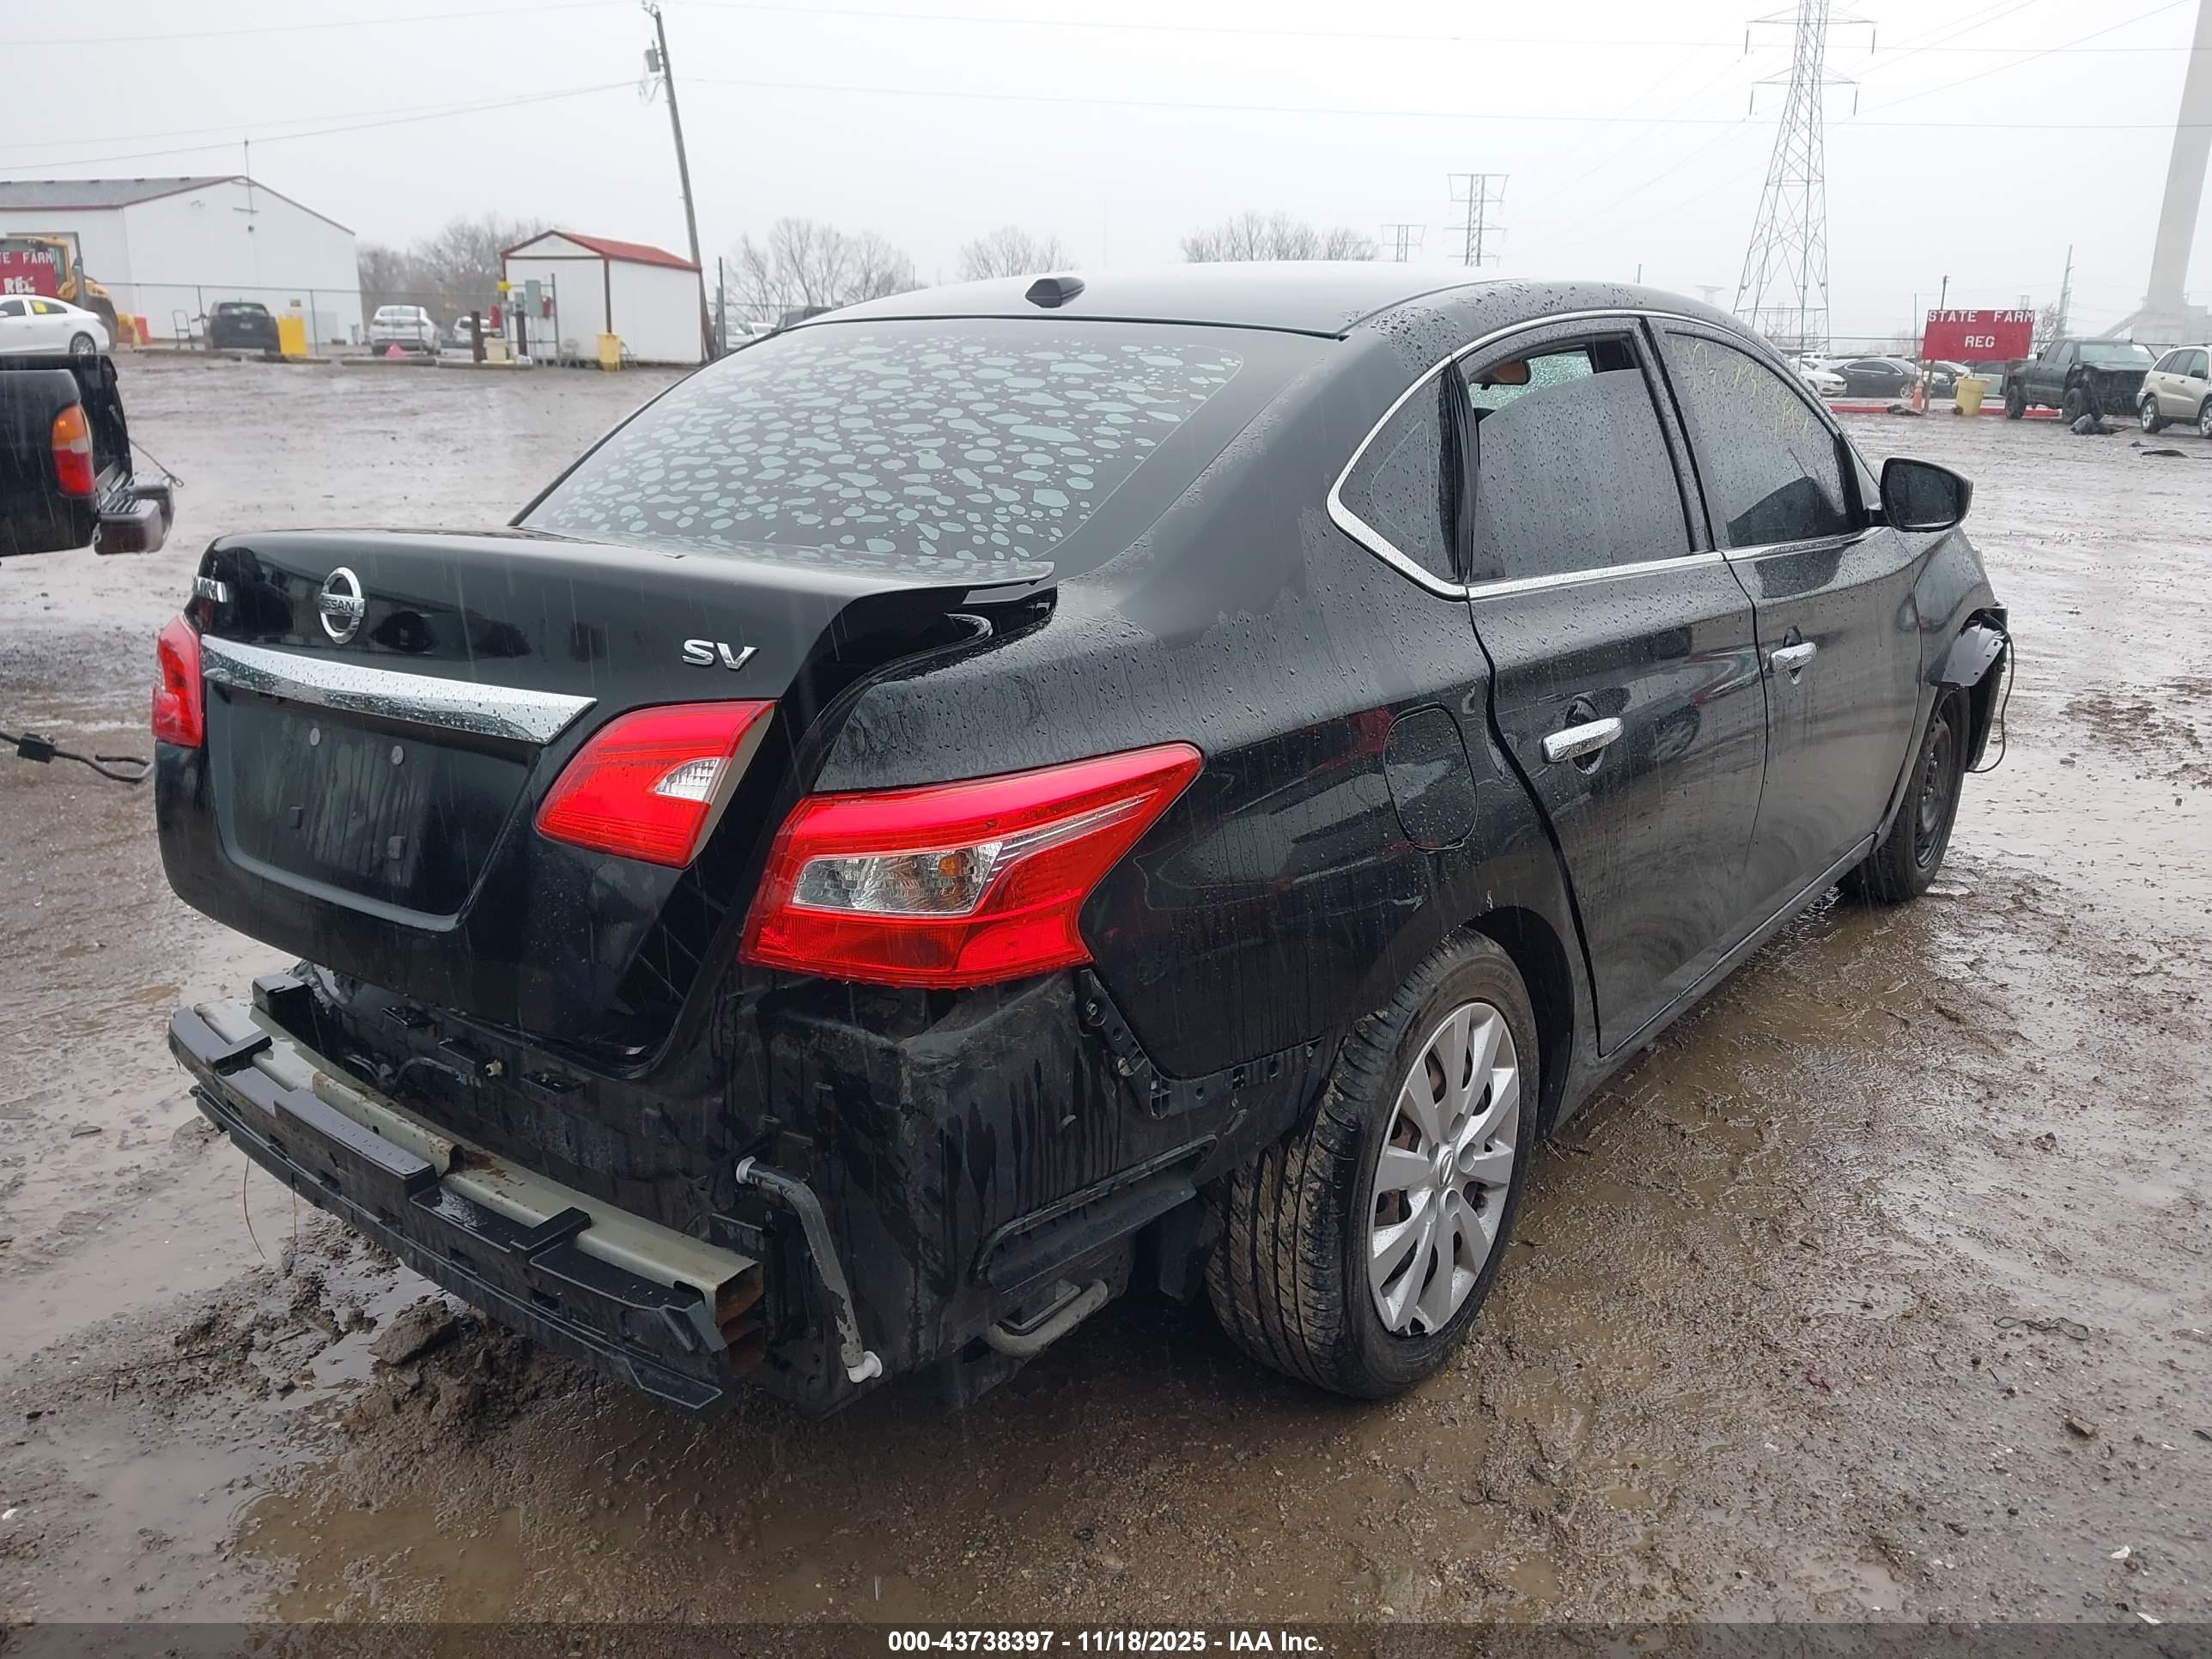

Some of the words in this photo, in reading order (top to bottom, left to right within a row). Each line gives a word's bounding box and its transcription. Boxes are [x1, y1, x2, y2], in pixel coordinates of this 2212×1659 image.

[22, 251, 55, 264] FARM
[1928, 310, 1978, 323] STATE
[1993, 310, 2034, 323] FARM
[1964, 336, 1996, 348] REG
[682, 639, 759, 670] SV
